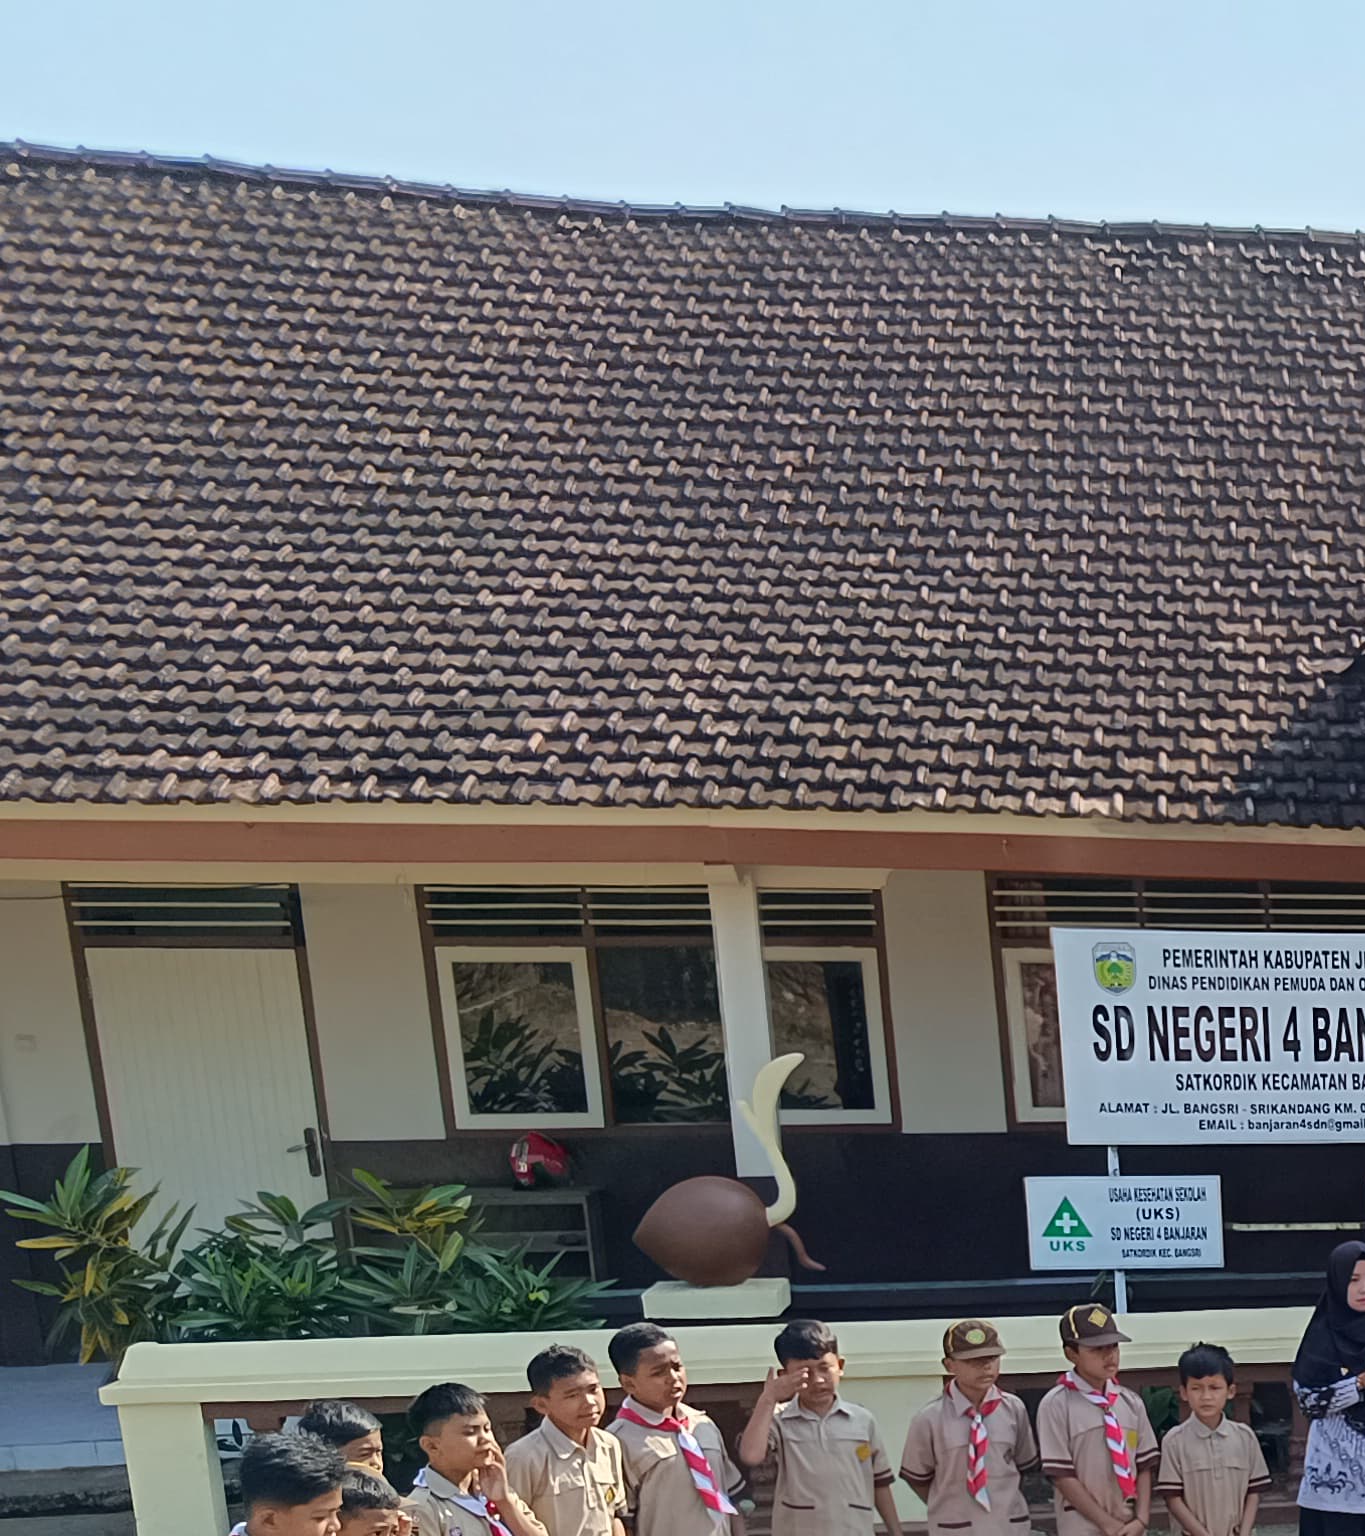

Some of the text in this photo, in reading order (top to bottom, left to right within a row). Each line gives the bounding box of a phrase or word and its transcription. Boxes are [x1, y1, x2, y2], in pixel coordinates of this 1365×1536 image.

[1162, 948, 1259, 969] PEMERINTAH
[1263, 949, 1350, 970] KABUPATEN
[1148, 975, 1188, 991] DINAS
[1191, 976, 1270, 991] PENDIDIKAN
[1274, 976, 1326, 992] PEMUDA
[1329, 977, 1355, 992] DAN
[1092, 1004, 1135, 1062] SD
[1146, 1005, 1271, 1063] NEGERI
[1282, 1005, 1302, 1063] 4
[1175, 1073, 1258, 1092] SATKORDIK
[1261, 1072, 1348, 1091] KECAMATAN
[1099, 1102, 1150, 1114] ALAMAT
[1161, 1102, 1180, 1114] JL.
[1183, 1102, 1239, 1115] BANGSRI
[1250, 1102, 1331, 1115] SRIKANDANG
[1334, 1102, 1357, 1114] KM.
[1198, 1119, 1237, 1131] EMAIL
[1108, 1187, 1133, 1203] USAHA
[1135, 1206, 1180, 1222] (UKS)
[1110, 1226, 1208, 1241] SD NEGERI 4 BANJARAN
[1049, 1240, 1086, 1252] UKS
